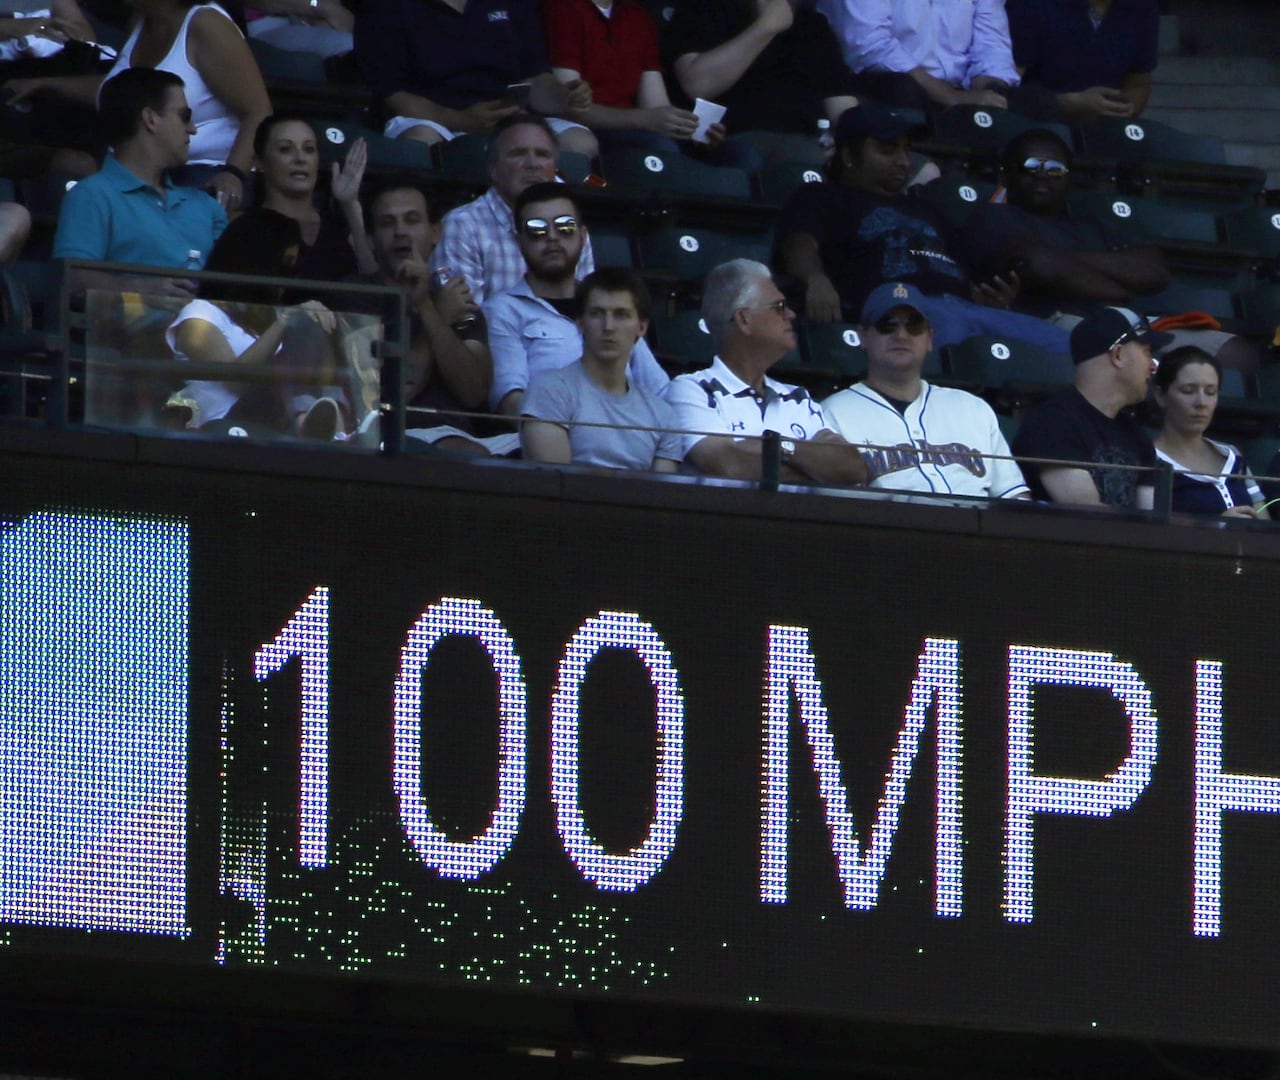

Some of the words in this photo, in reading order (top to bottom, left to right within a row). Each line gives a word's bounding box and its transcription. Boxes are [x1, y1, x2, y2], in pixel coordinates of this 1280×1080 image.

[977, 114, 989, 125] 13
[1129, 128, 1140, 138] 14
[963, 188, 973, 199] 11
[1116, 204, 1127, 215] 12
[253, 585, 686, 895] 100
